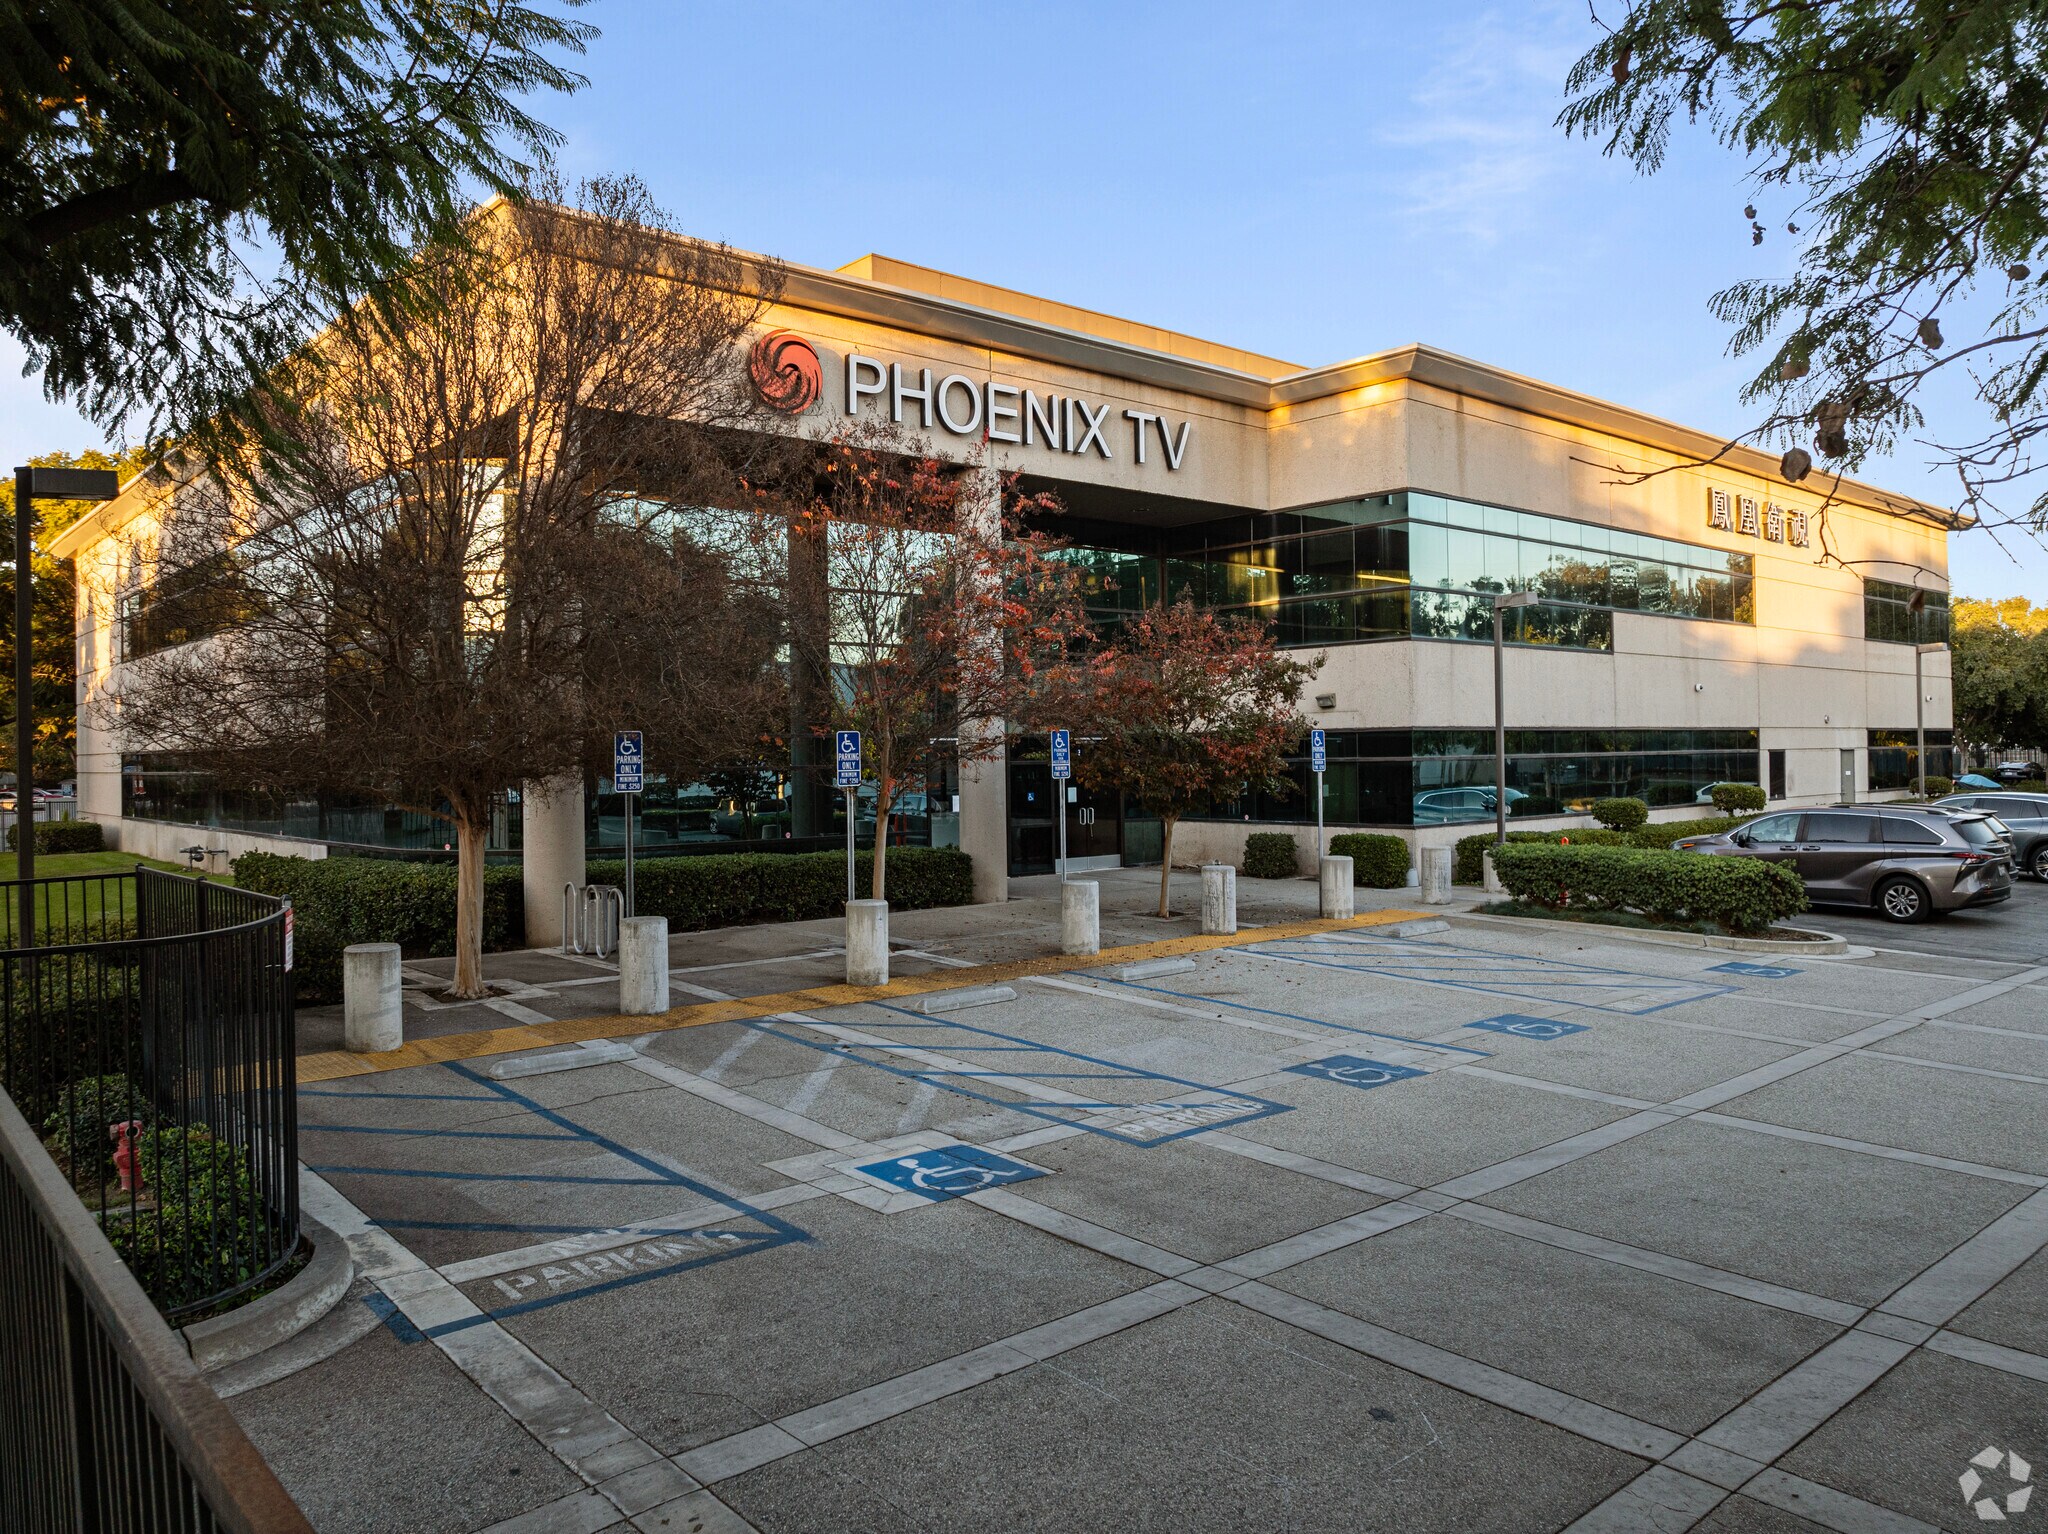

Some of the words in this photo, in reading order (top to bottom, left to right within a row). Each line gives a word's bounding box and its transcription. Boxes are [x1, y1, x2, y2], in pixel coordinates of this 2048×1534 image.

[845, 353, 1112, 459] PHOENIX
[1123, 409, 1191, 470] TV
[1708, 487, 1808, 546] 鳳凰衛視
[616, 755, 641, 764] PARKING
[838, 753, 859, 761] PARKING
[620, 765, 637, 774] ONLY
[841, 761, 856, 770] ONLY
[628, 782, 641, 790] $250
